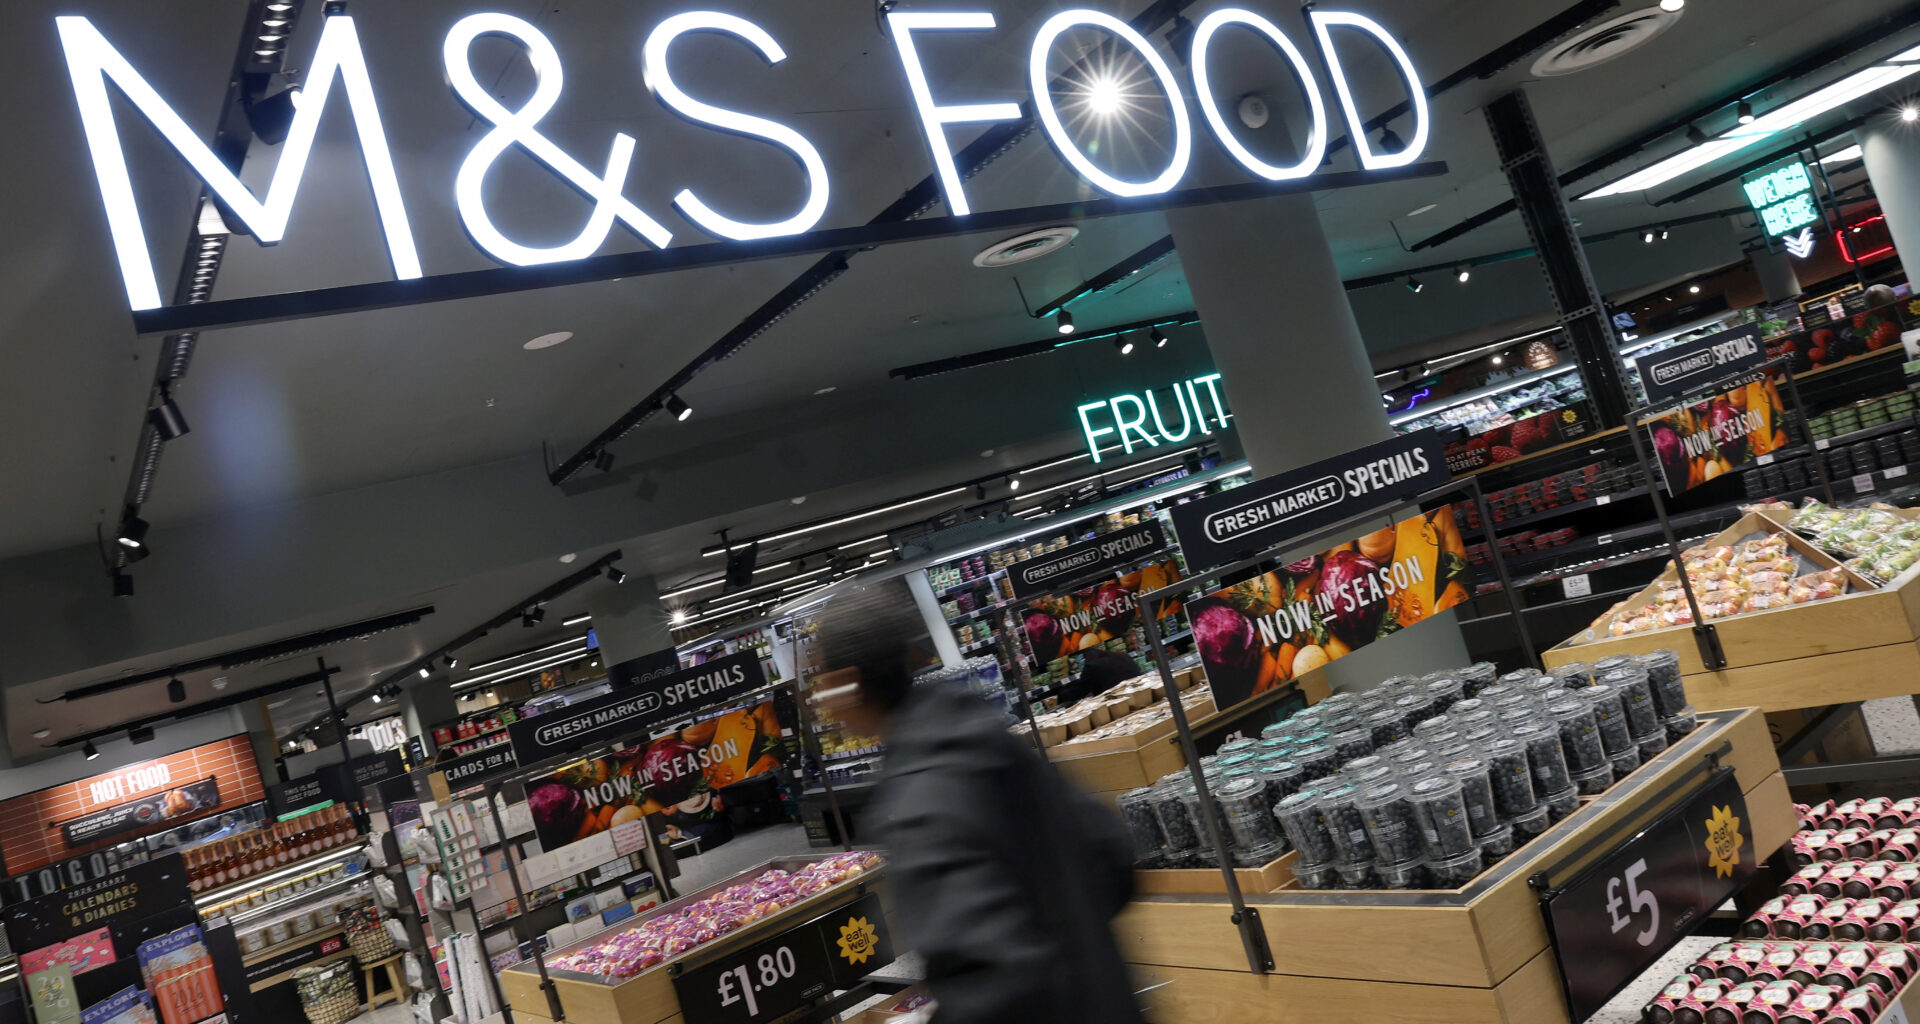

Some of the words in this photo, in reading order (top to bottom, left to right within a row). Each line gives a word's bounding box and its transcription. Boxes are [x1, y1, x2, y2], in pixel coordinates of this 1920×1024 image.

[55, 10, 830, 313] M&S
[886, 8, 1429, 217] FOOD
[1743, 162, 1811, 208] WEIGH
[1761, 193, 1818, 237] HERE
[1655, 363, 1681, 381] FRESH
[1680, 353, 1712, 374] MARKET
[1711, 335, 1758, 365] SPECIALS
[1077, 373, 1228, 464] FRUIT
[1684, 430, 1713, 459] NOW
[1710, 425, 1723, 441] IN
[1721, 408, 1765, 442] SEASON
[1214, 504, 1272, 536] FRESH
[1272, 481, 1338, 517] MARKET
[1343, 447, 1430, 498] SPECIALS
[1027, 564, 1060, 581] FRESH
[1058, 551, 1097, 571] MARKET
[1101, 529, 1155, 559] SPECIALS
[1059, 610, 1092, 635] NOW
[1092, 603, 1105, 619] IN
[1257, 599, 1313, 648] NOW
[1314, 591, 1337, 616] IN
[1339, 554, 1425, 613] SEASON
[543, 715, 593, 742] FRESH
[594, 695, 655, 726] MARKET
[663, 664, 746, 706] SPECIALS
[89, 774, 126, 805] HOT
[126, 763, 171, 794] FOOD
[446, 761, 485, 781] CARDS
[486, 754, 502, 766] FOR
[583, 774, 633, 809] NOW
[636, 768, 655, 785] IN
[659, 737, 740, 782] SEASON
[62, 882, 139, 917] CALENDARS
[71, 916, 82, 928] &
[84, 897, 137, 923] DIARIES
[1606, 857, 1661, 947] £5
[145, 928, 197, 953] EXPLORE
[845, 927, 864, 943] eat
[847, 932, 871, 951] well
[717, 945, 796, 1017] £1.80
[84, 991, 137, 1022] EXPLORE
